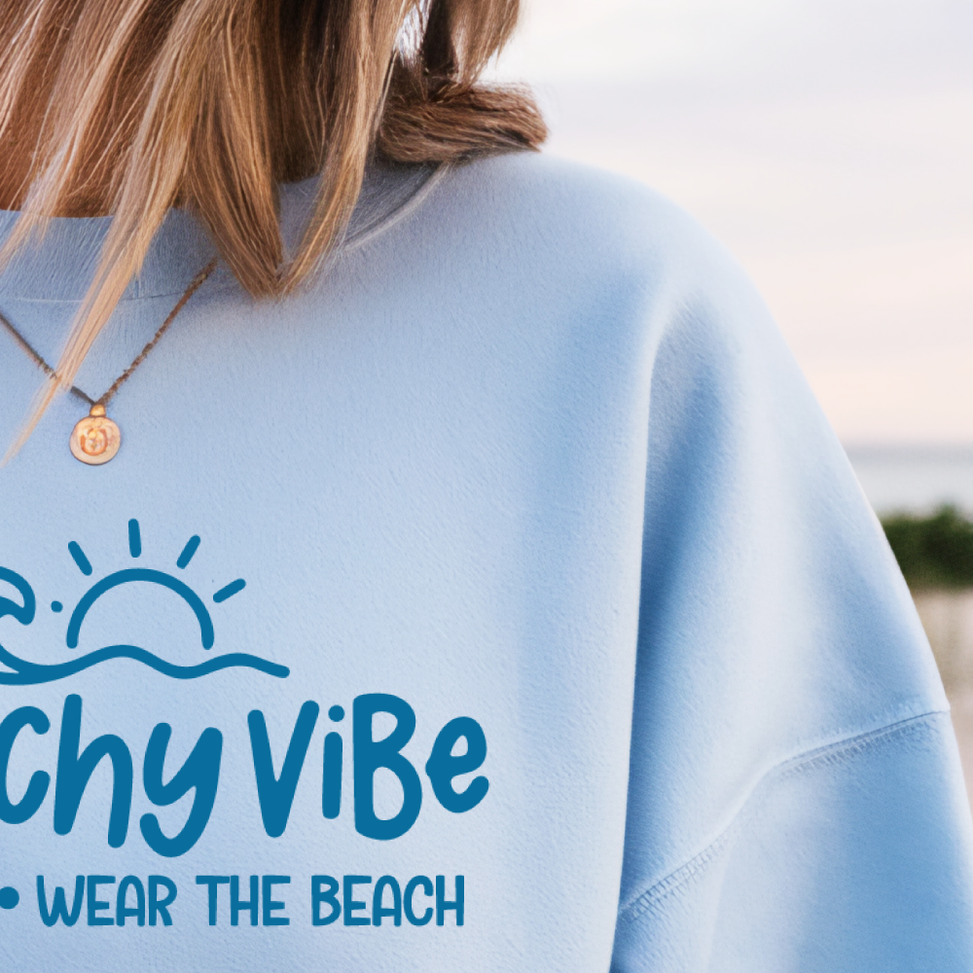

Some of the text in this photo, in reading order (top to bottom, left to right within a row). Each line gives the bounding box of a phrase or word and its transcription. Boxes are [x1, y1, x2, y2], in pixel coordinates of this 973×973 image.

[36, 874, 178, 928] WEAR
[195, 874, 291, 927] THE
[311, 874, 465, 927] BEACH
